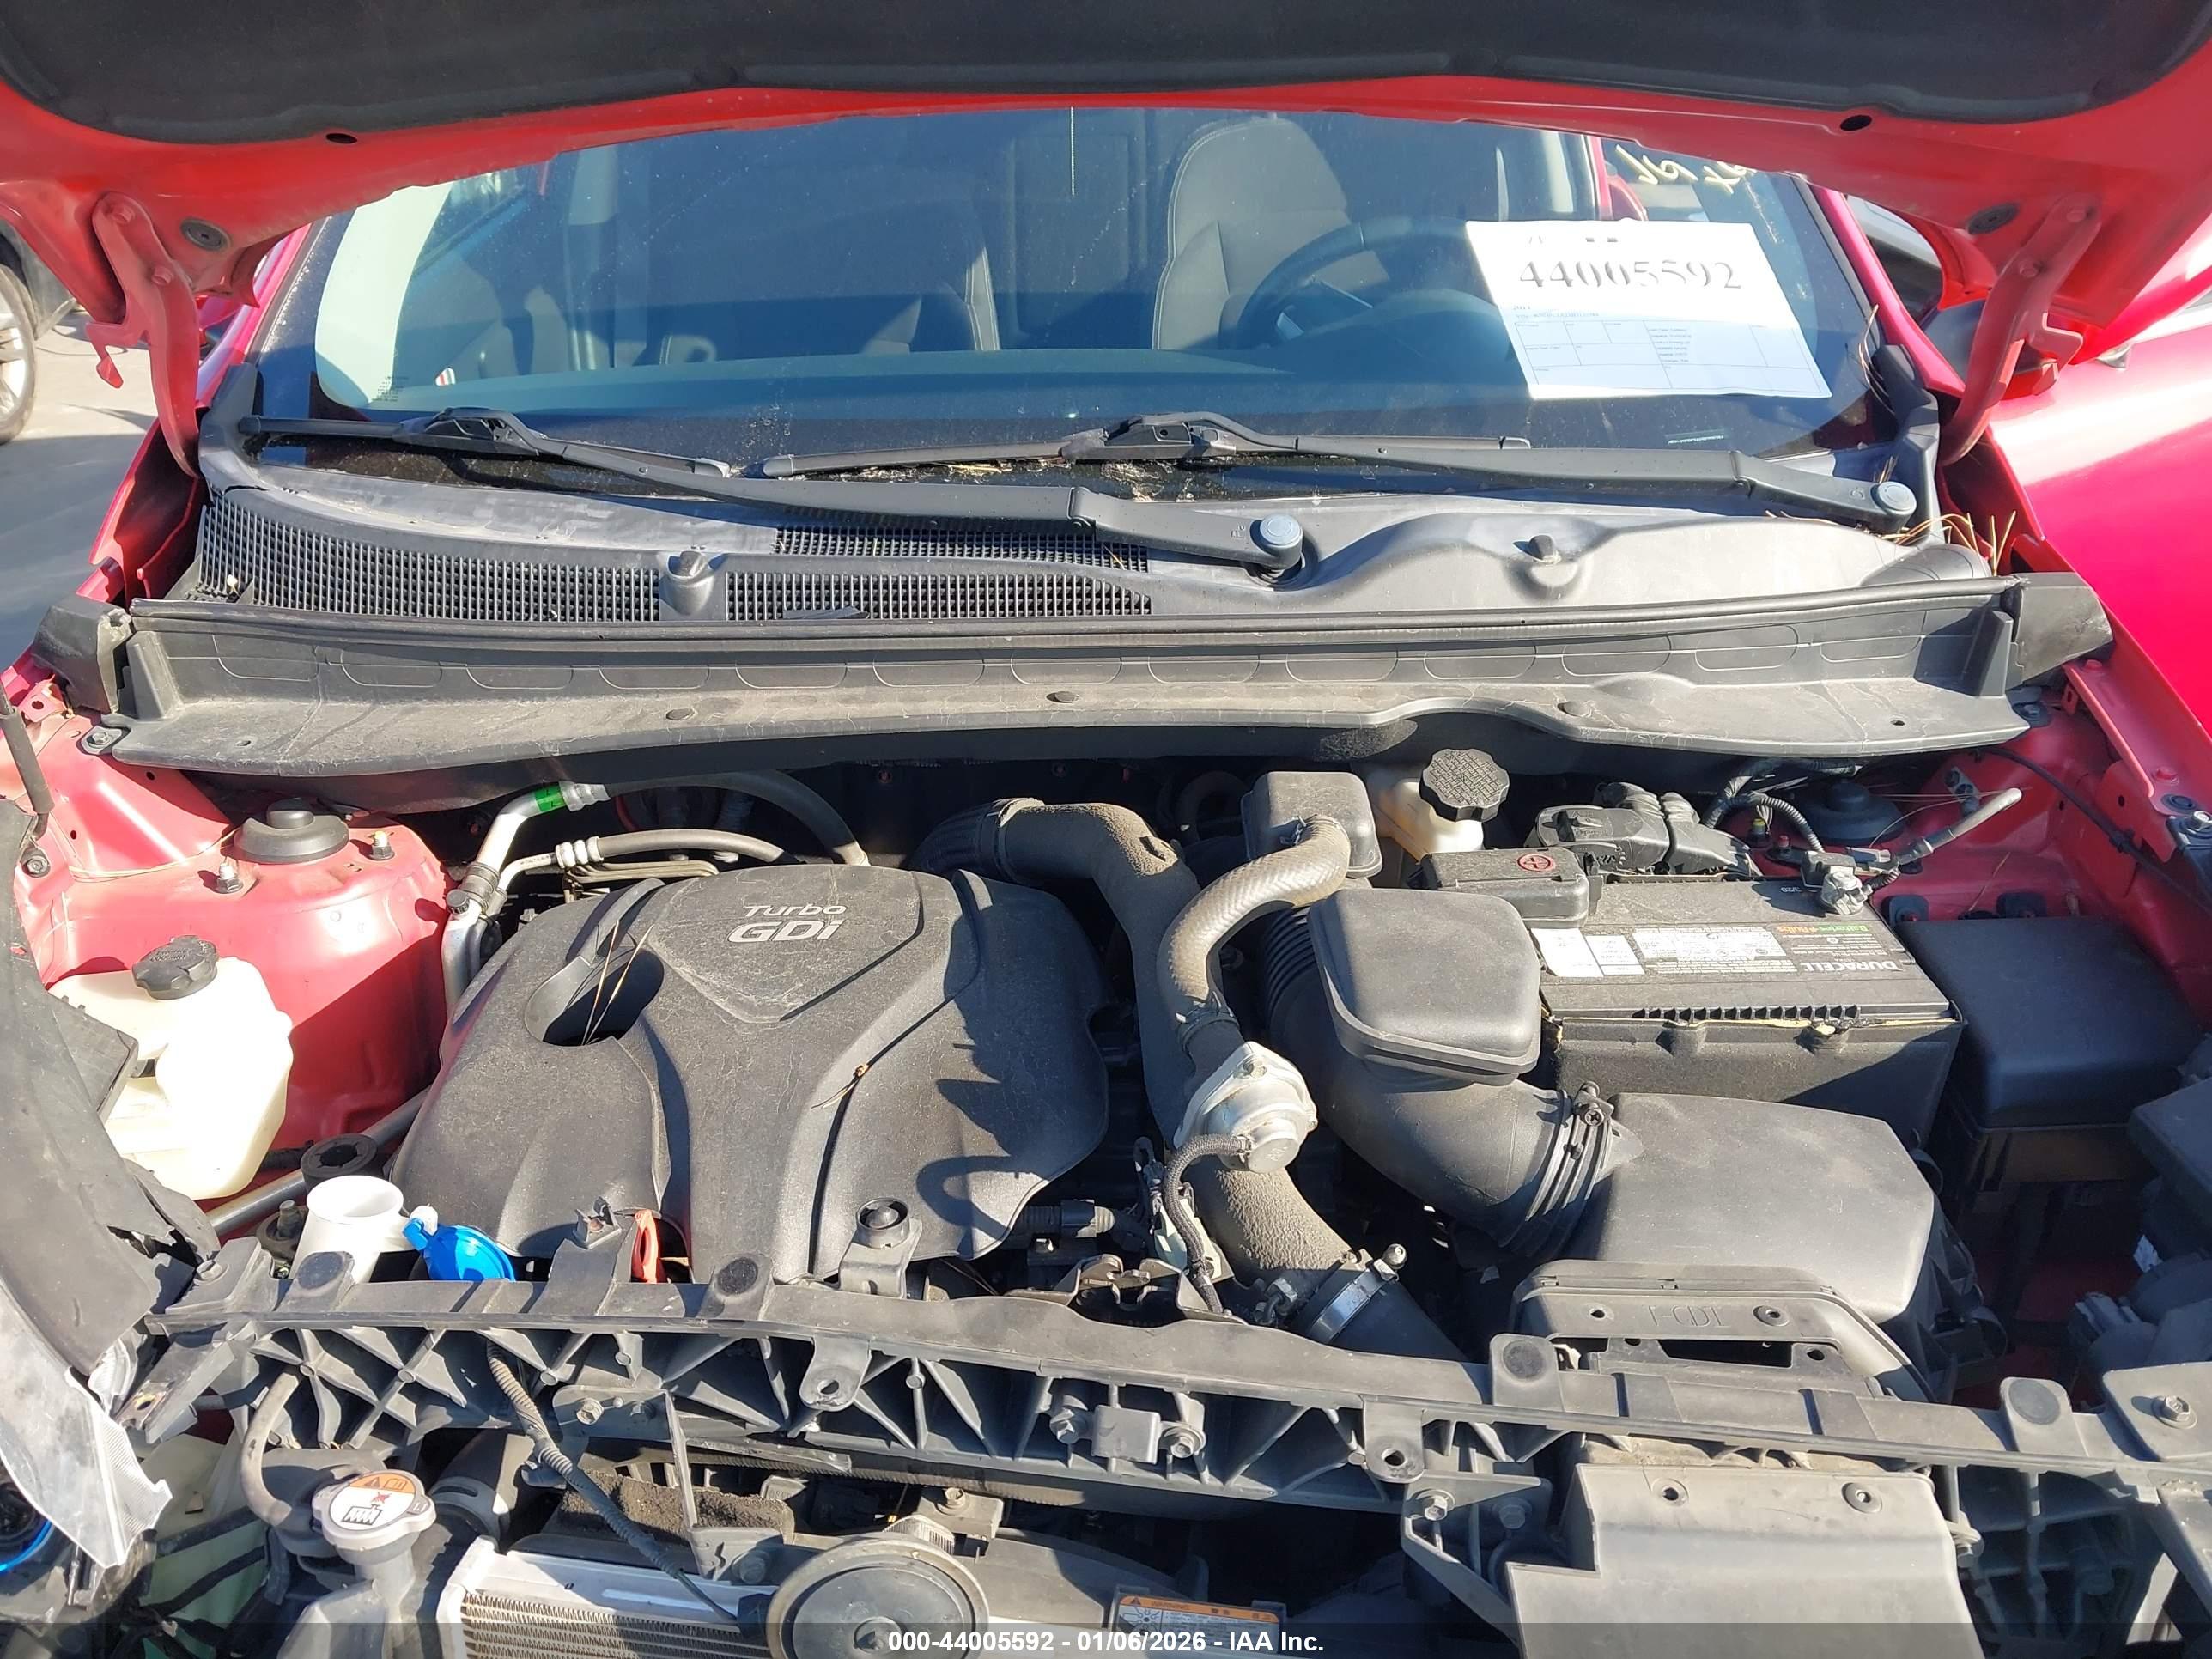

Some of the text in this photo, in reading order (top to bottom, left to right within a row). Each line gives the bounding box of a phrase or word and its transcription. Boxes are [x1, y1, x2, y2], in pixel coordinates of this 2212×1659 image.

[1520, 260, 1741, 289] 44005592
[743, 903, 848, 917] Turbo
[1800, 961, 1902, 971] DURACELL
